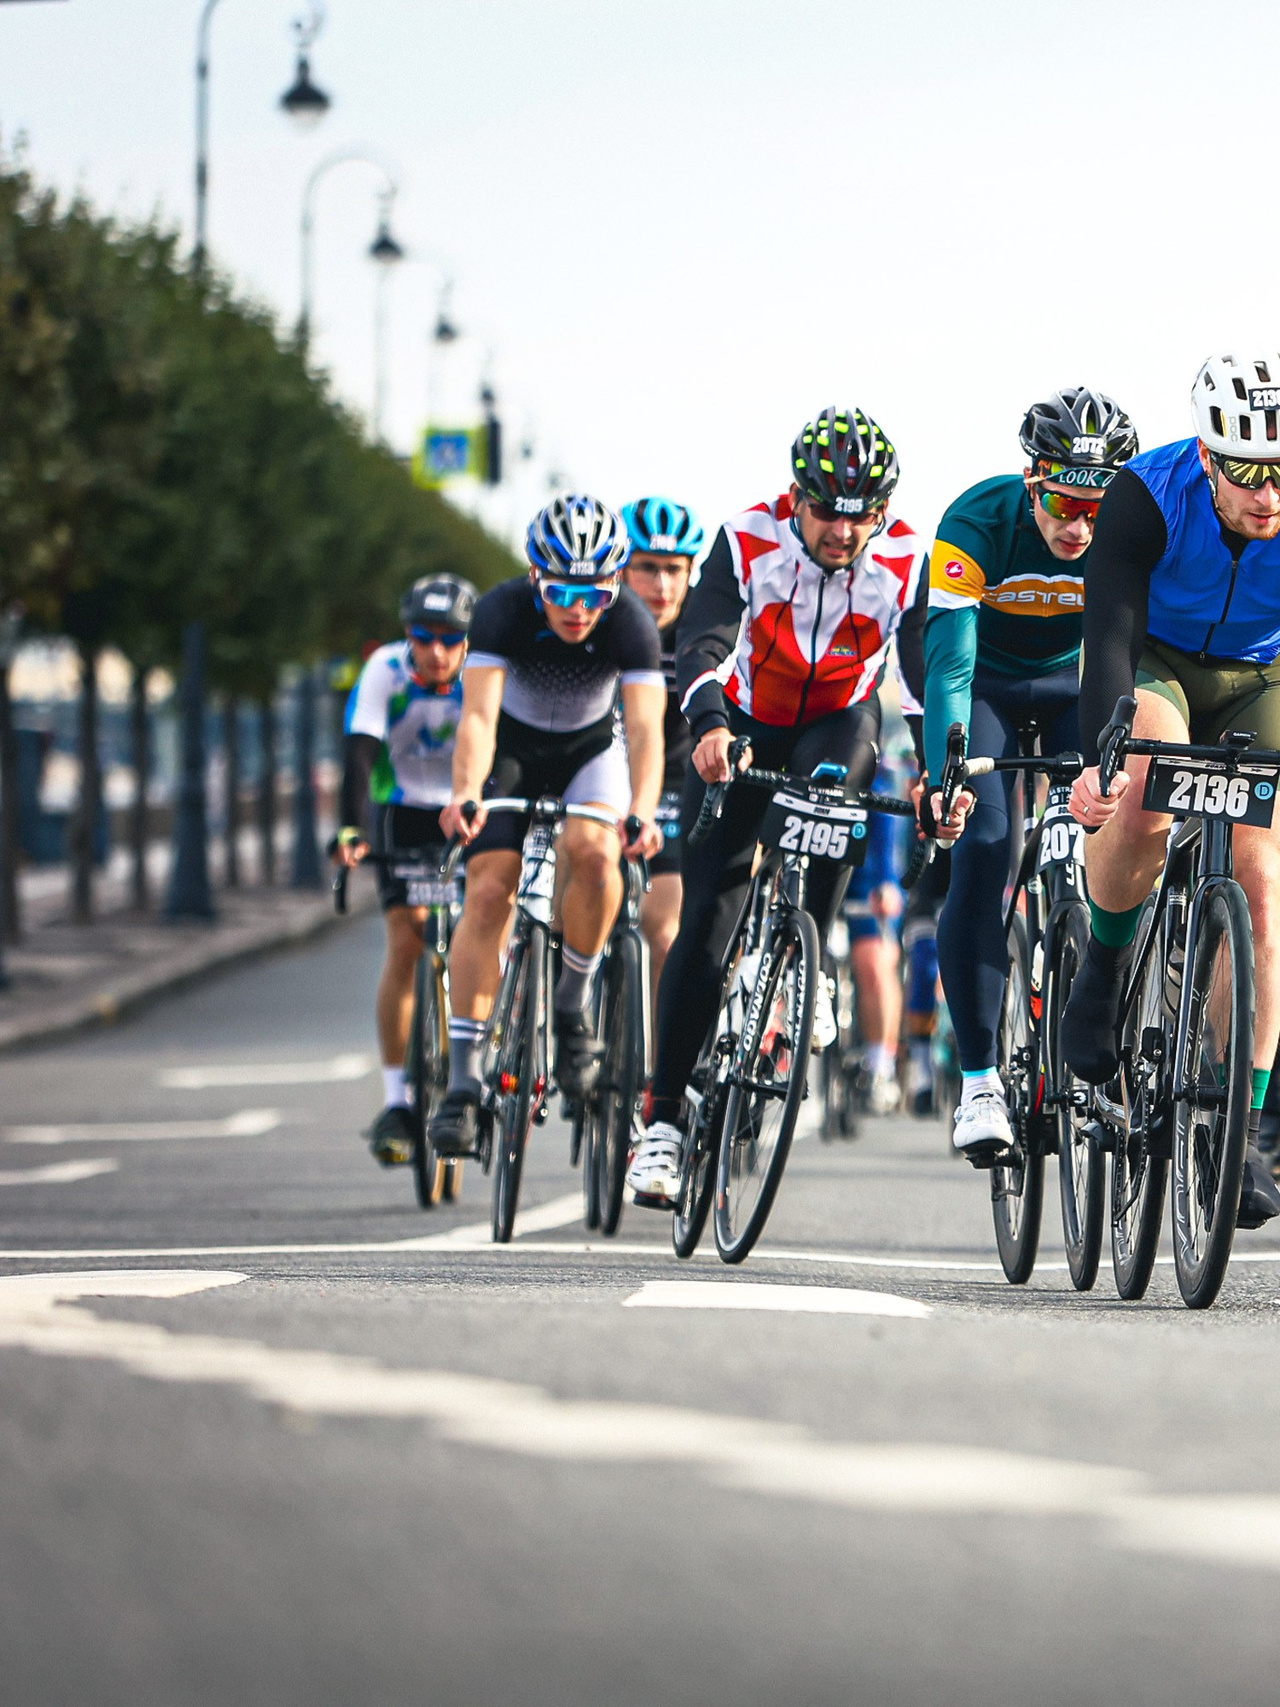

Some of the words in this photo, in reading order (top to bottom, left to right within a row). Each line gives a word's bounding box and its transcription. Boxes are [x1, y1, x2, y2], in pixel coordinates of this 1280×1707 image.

[1072, 437, 1104, 454] 2072
[1059, 470, 1100, 487] LOOK
[834, 496, 863, 513] 2195
[1168, 771, 1250, 818] 2136
[779, 815, 850, 859] 2195
[1040, 823, 1086, 867] 207
[743, 952, 772, 1052] COLNAGO
